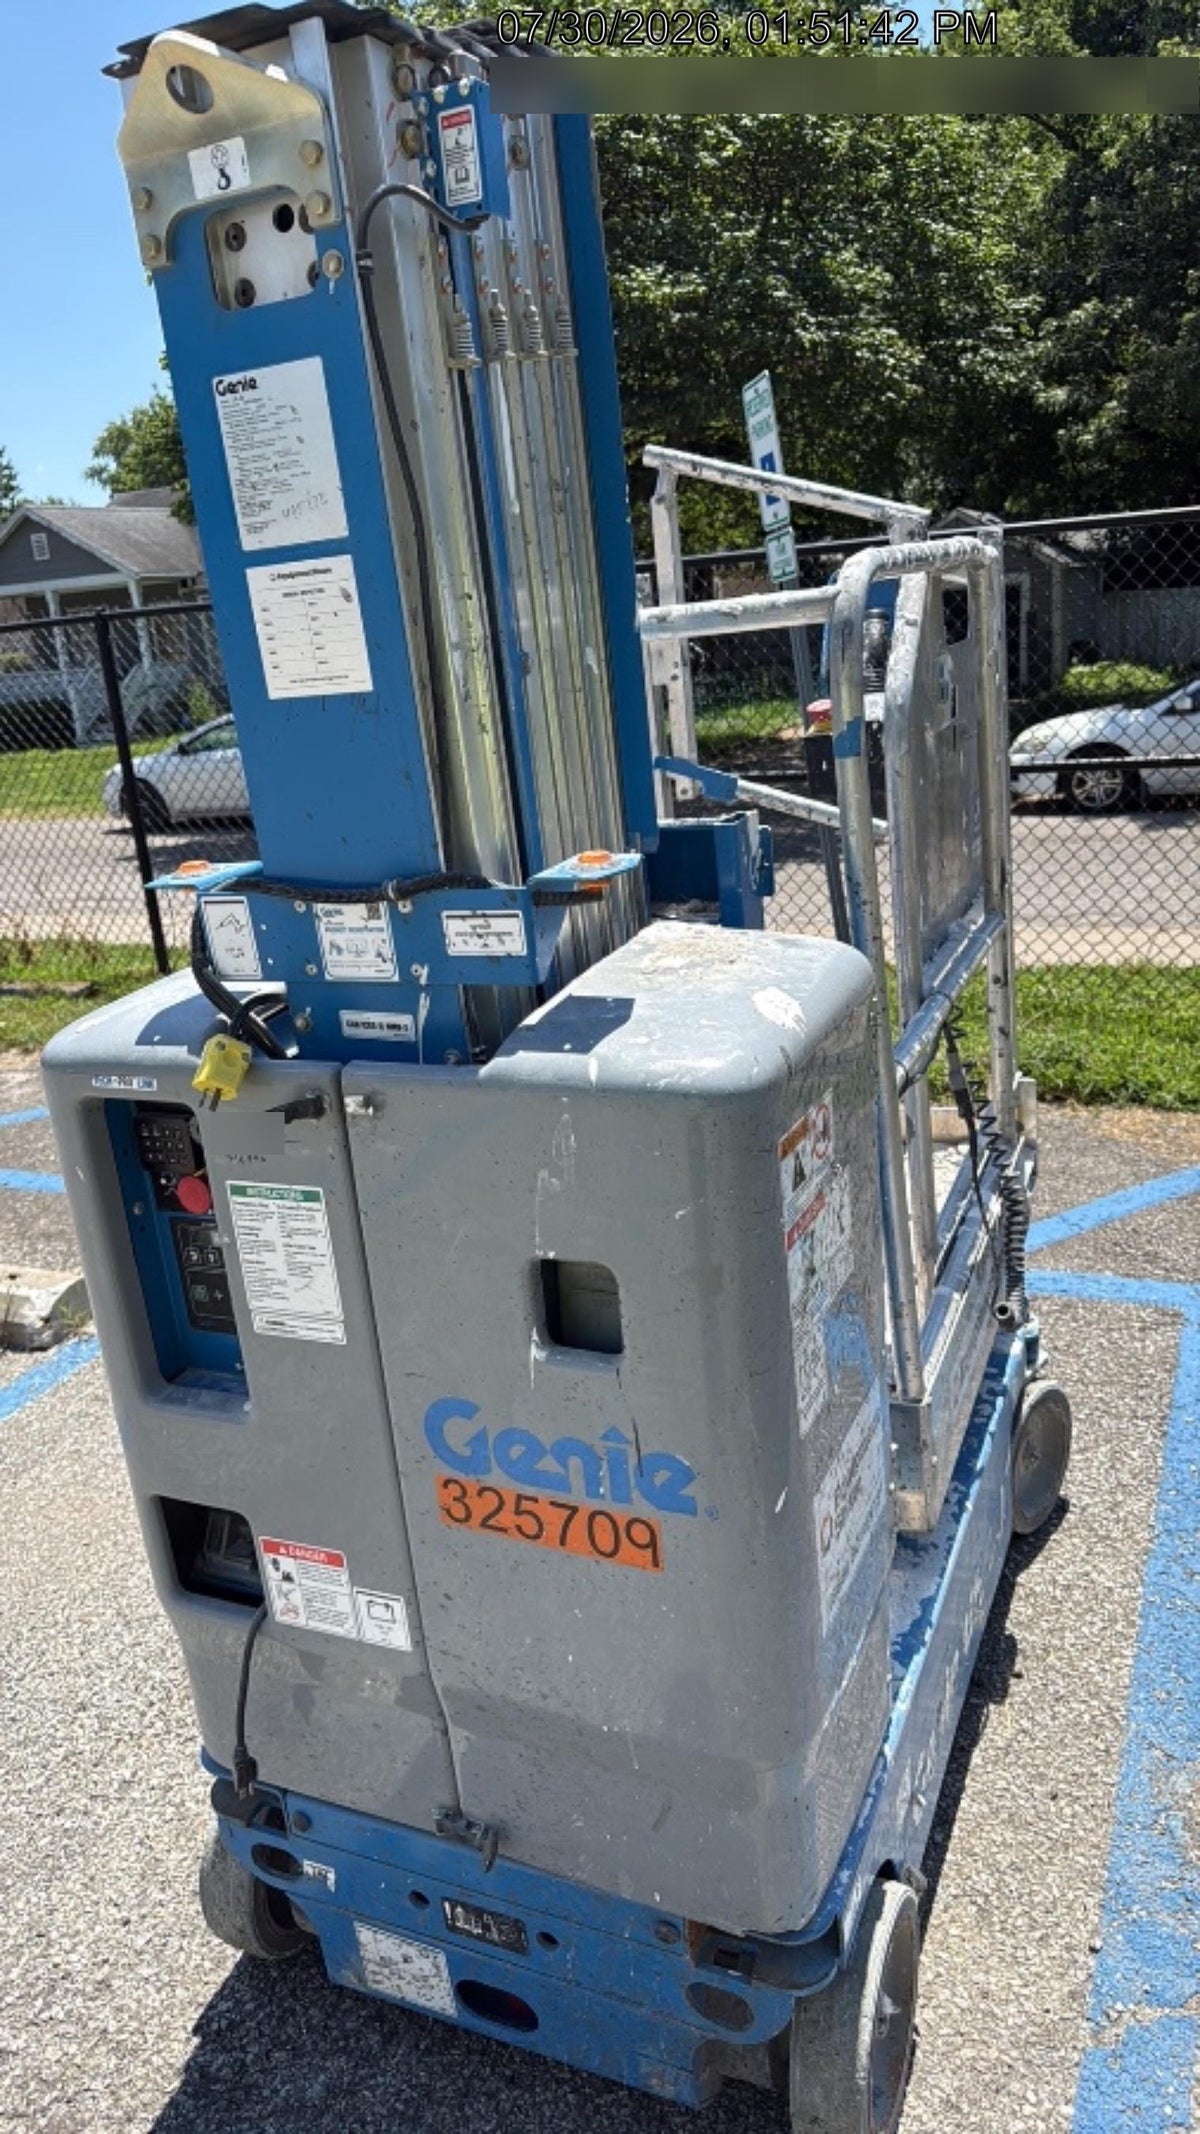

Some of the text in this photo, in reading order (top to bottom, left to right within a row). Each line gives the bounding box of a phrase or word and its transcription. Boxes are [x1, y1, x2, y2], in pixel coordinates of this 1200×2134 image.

[215, 375, 258, 397] Genie
[424, 1397, 697, 1516] Genie
[440, 1478, 661, 1569] 325709
